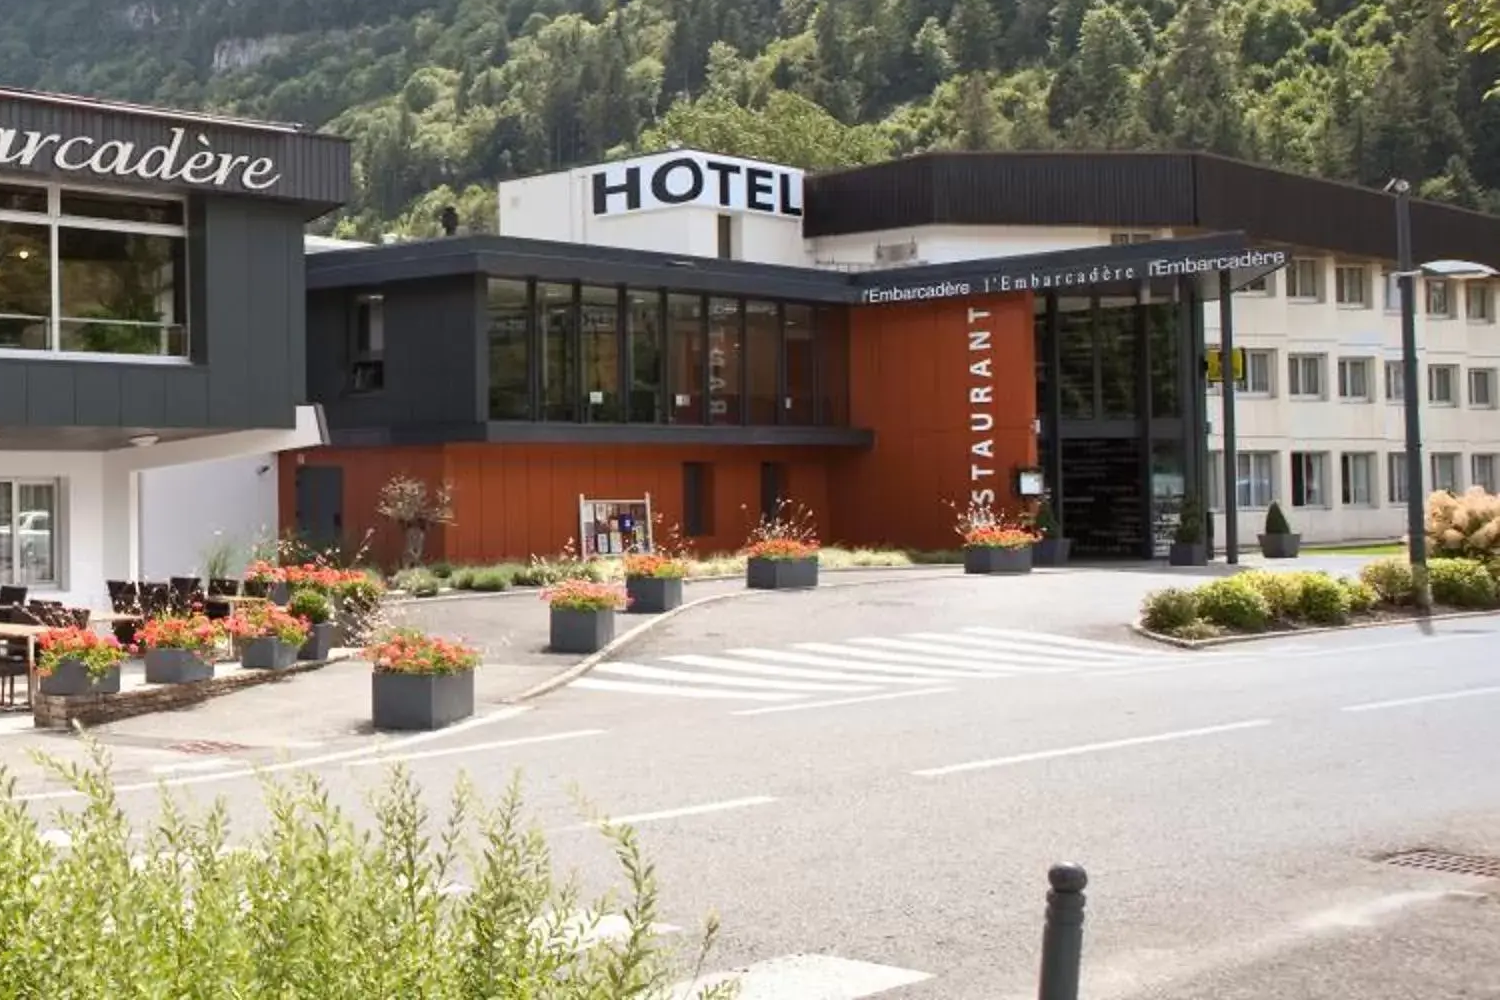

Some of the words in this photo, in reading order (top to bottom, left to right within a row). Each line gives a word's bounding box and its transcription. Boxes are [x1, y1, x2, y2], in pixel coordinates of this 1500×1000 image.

[592, 157, 803, 216] HOTEL
[985, 265, 1134, 293] l'Embarcadère
[968, 307, 995, 529] ESTAURANT
